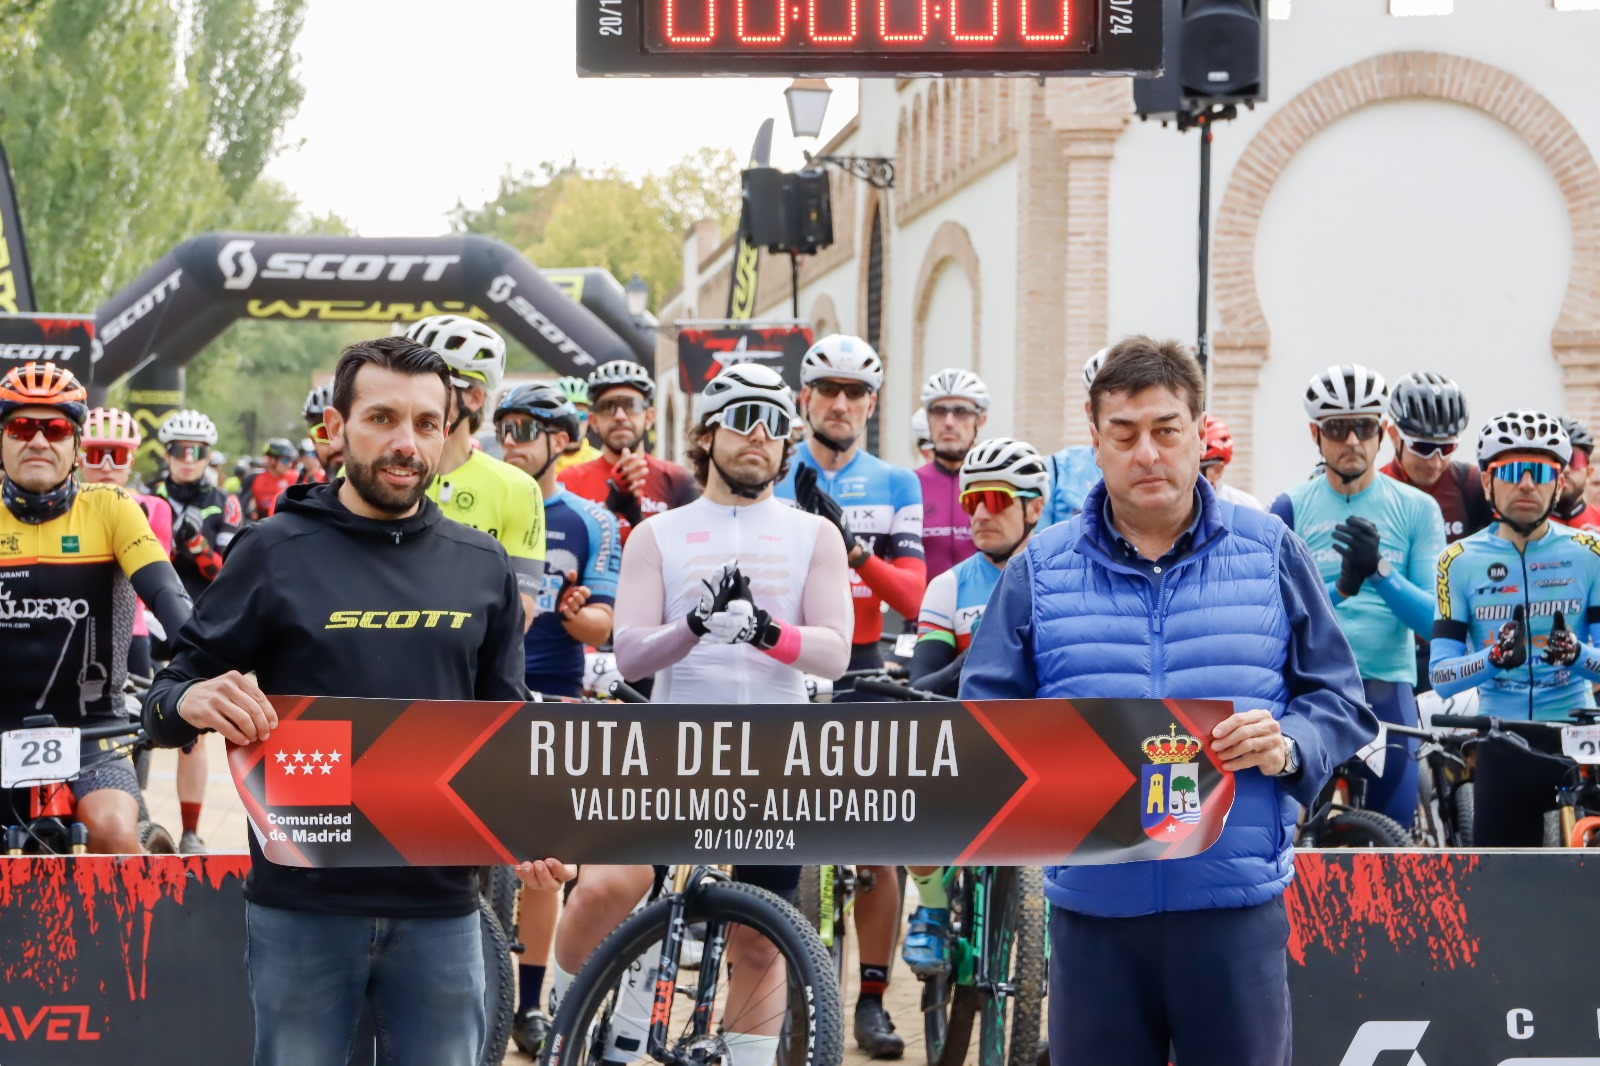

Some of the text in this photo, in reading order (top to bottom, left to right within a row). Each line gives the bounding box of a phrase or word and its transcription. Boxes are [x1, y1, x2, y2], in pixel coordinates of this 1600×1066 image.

[260, 252, 461, 281] SCOTT
[100, 268, 183, 346] SCOTT
[506, 295, 597, 367] SCOTT
[0, 343, 80, 361] COTT
[324, 610, 473, 630] SCOTT
[21, 739, 62, 767] 28
[530, 719, 959, 777] RUTA DEL AGUILA
[571, 787, 917, 822] VALDEOLMOS-ALALPARDO
[266, 812, 352, 826] Comunidad
[269, 828, 352, 843] de Madrid
[694, 828, 796, 850] 20/10/2024
